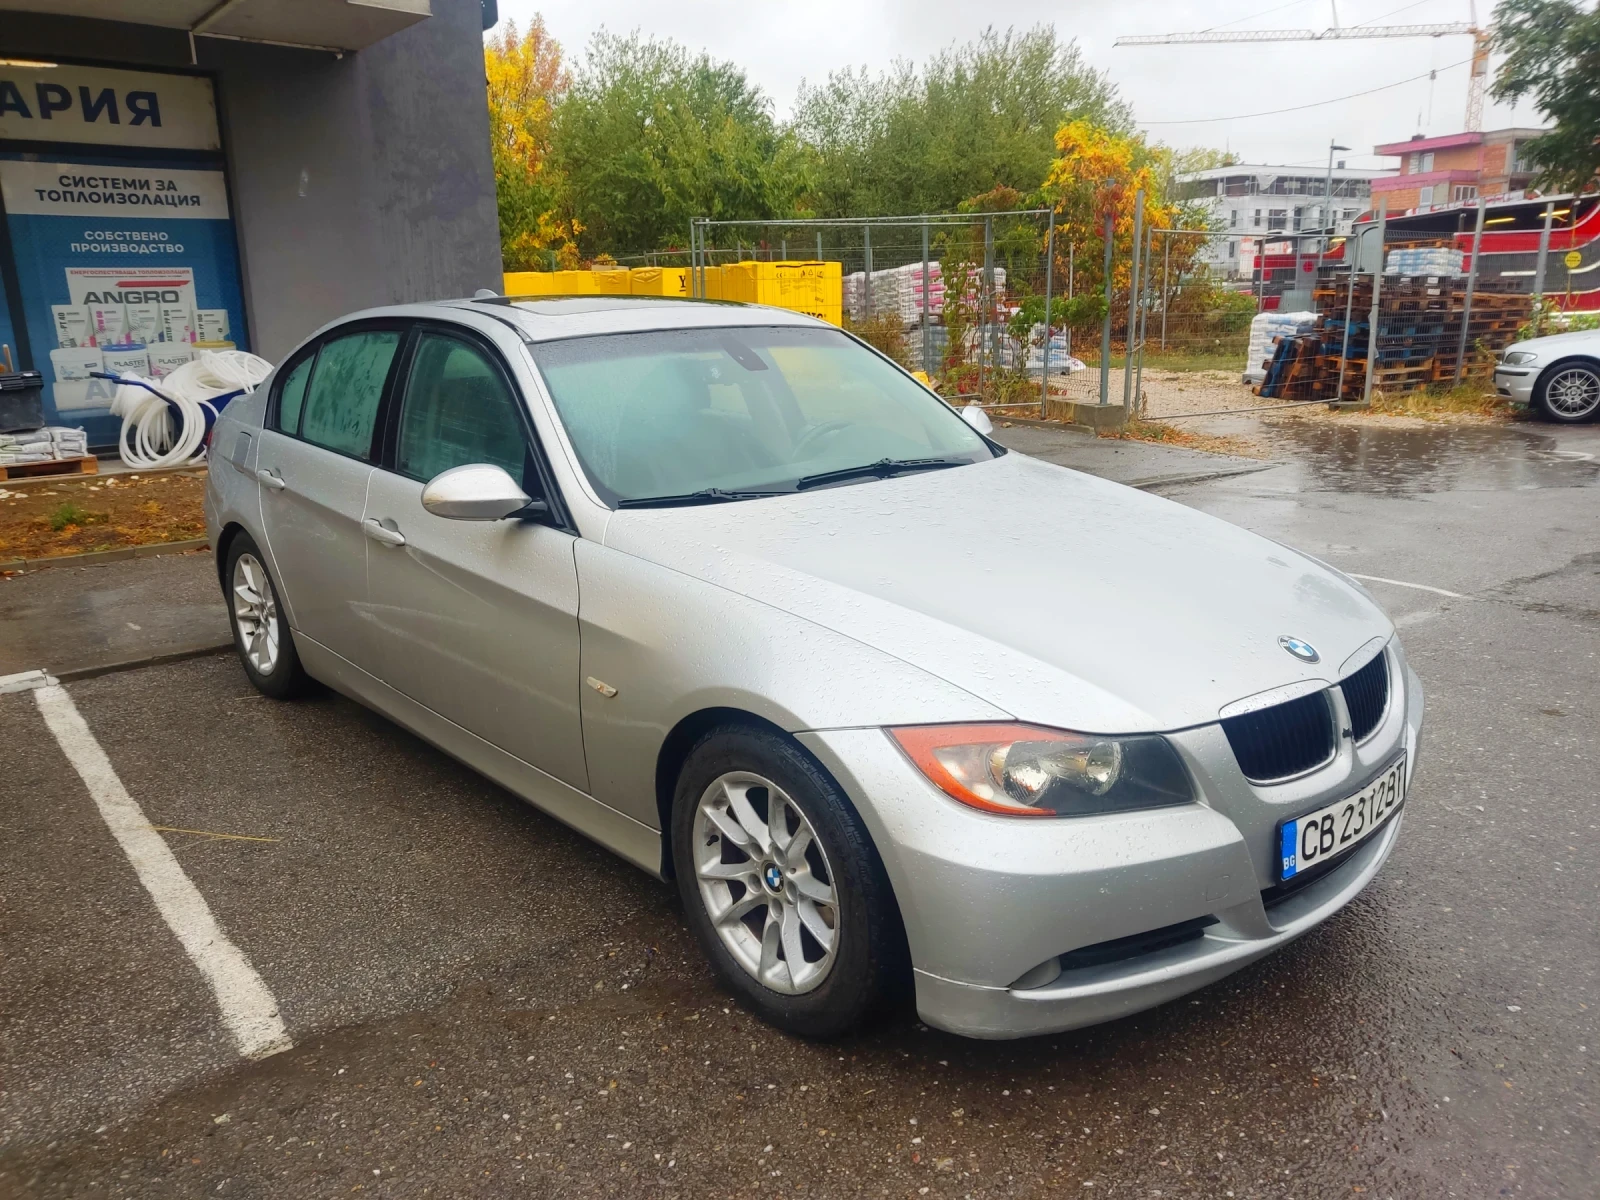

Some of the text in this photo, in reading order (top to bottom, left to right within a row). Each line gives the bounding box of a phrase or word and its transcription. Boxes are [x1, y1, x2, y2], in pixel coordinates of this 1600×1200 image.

[58, 174, 178, 192] СИСТЕМИ ЗА
[35, 189, 201, 208] ТОПЛОИЗОЛАЦИЯ
[84, 230, 169, 241] СОБСТВЕНО
[71, 243, 184, 254] ПРОИЗВОДСТВО
[83, 290, 180, 305] ANGRO
[114, 359, 146, 368] PLASTER
[158, 357, 189, 365] PLASTER
[1283, 854, 1296, 870] BG
